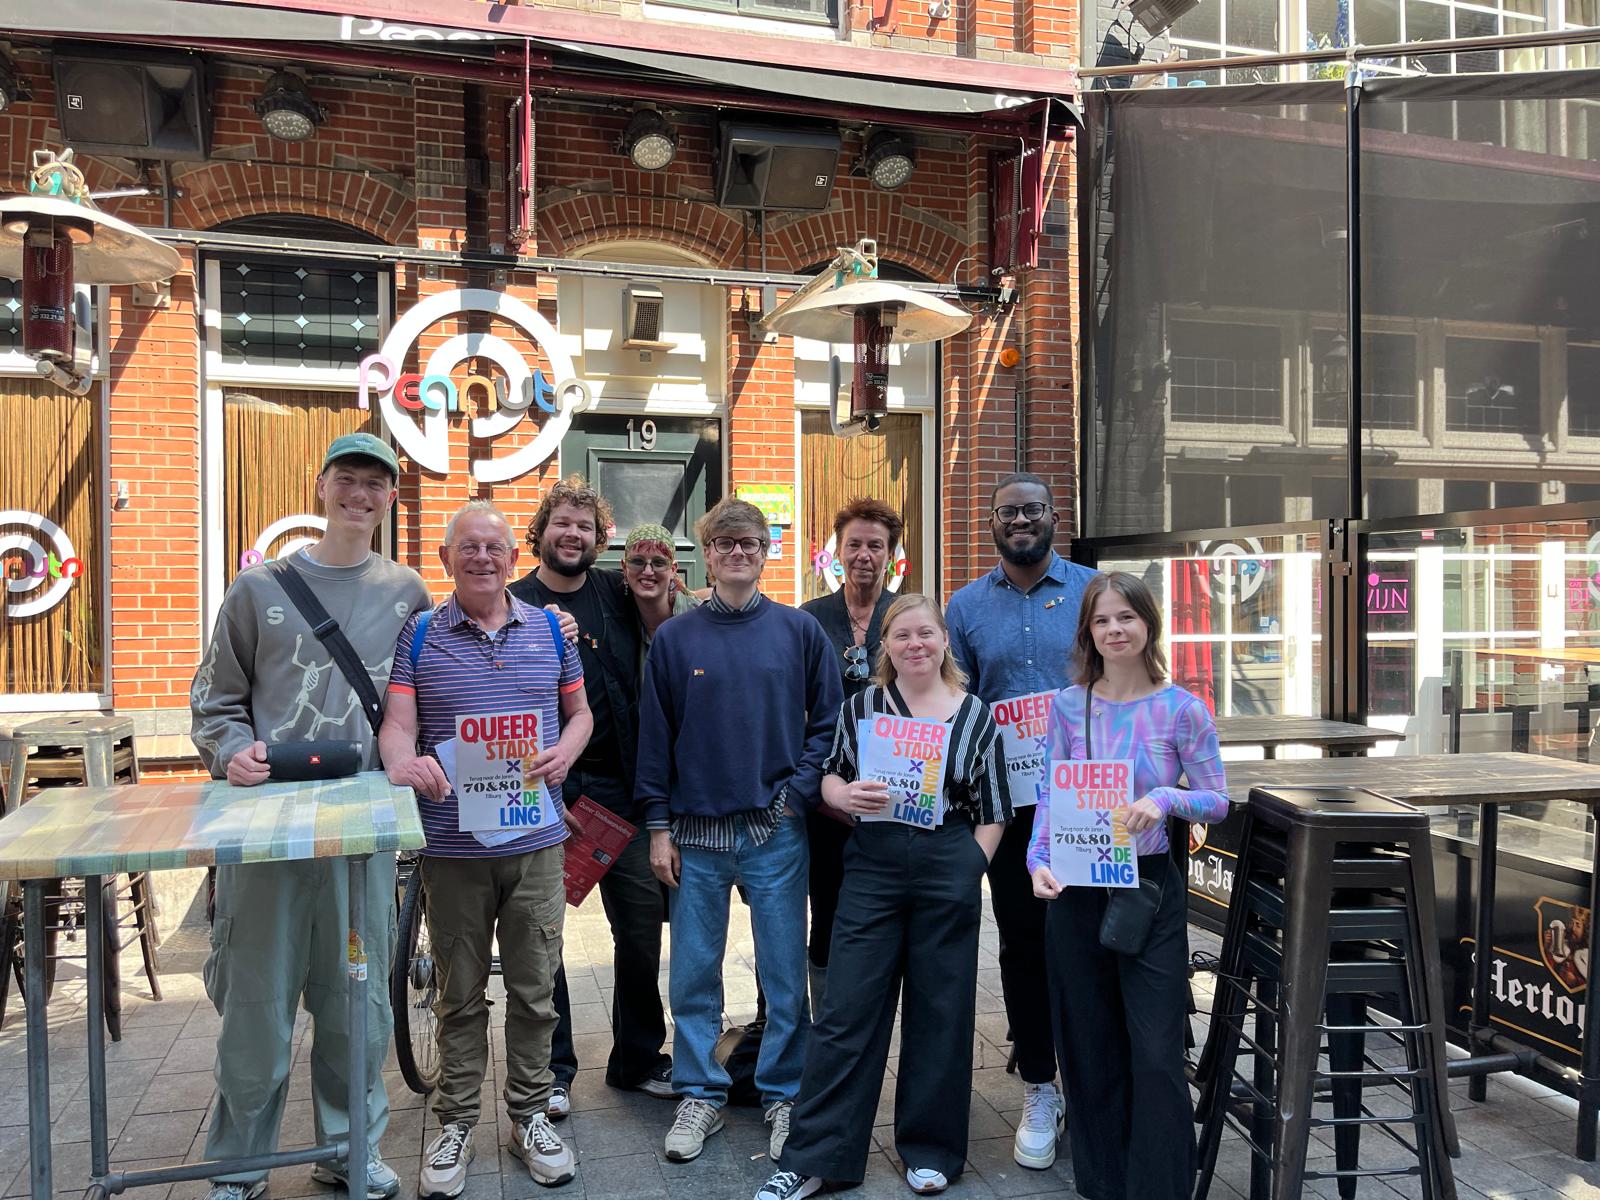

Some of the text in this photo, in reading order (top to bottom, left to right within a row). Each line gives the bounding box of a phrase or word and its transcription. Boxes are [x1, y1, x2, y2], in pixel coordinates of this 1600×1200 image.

[626, 418, 657, 450] 19
[460, 713, 538, 744] QUEER
[875, 716, 946, 744] QUEER
[1015, 717, 1049, 740] STA
[485, 737, 539, 761] STADS
[893, 740, 943, 761] STADS
[463, 780, 521, 793] 70&80
[873, 775, 920, 791] 0&80
[1055, 763, 1129, 791] QUEER
[523, 791, 540, 806] DE
[919, 793, 936, 809] DE
[1076, 789, 1129, 810] STADS
[500, 806, 541, 826] LING
[893, 803, 934, 826] LING
[1055, 833, 1111, 845] 70&80
[1114, 847, 1131, 862] DE
[1090, 863, 1134, 884] LING
[1206, 855, 1235, 894] Ja
